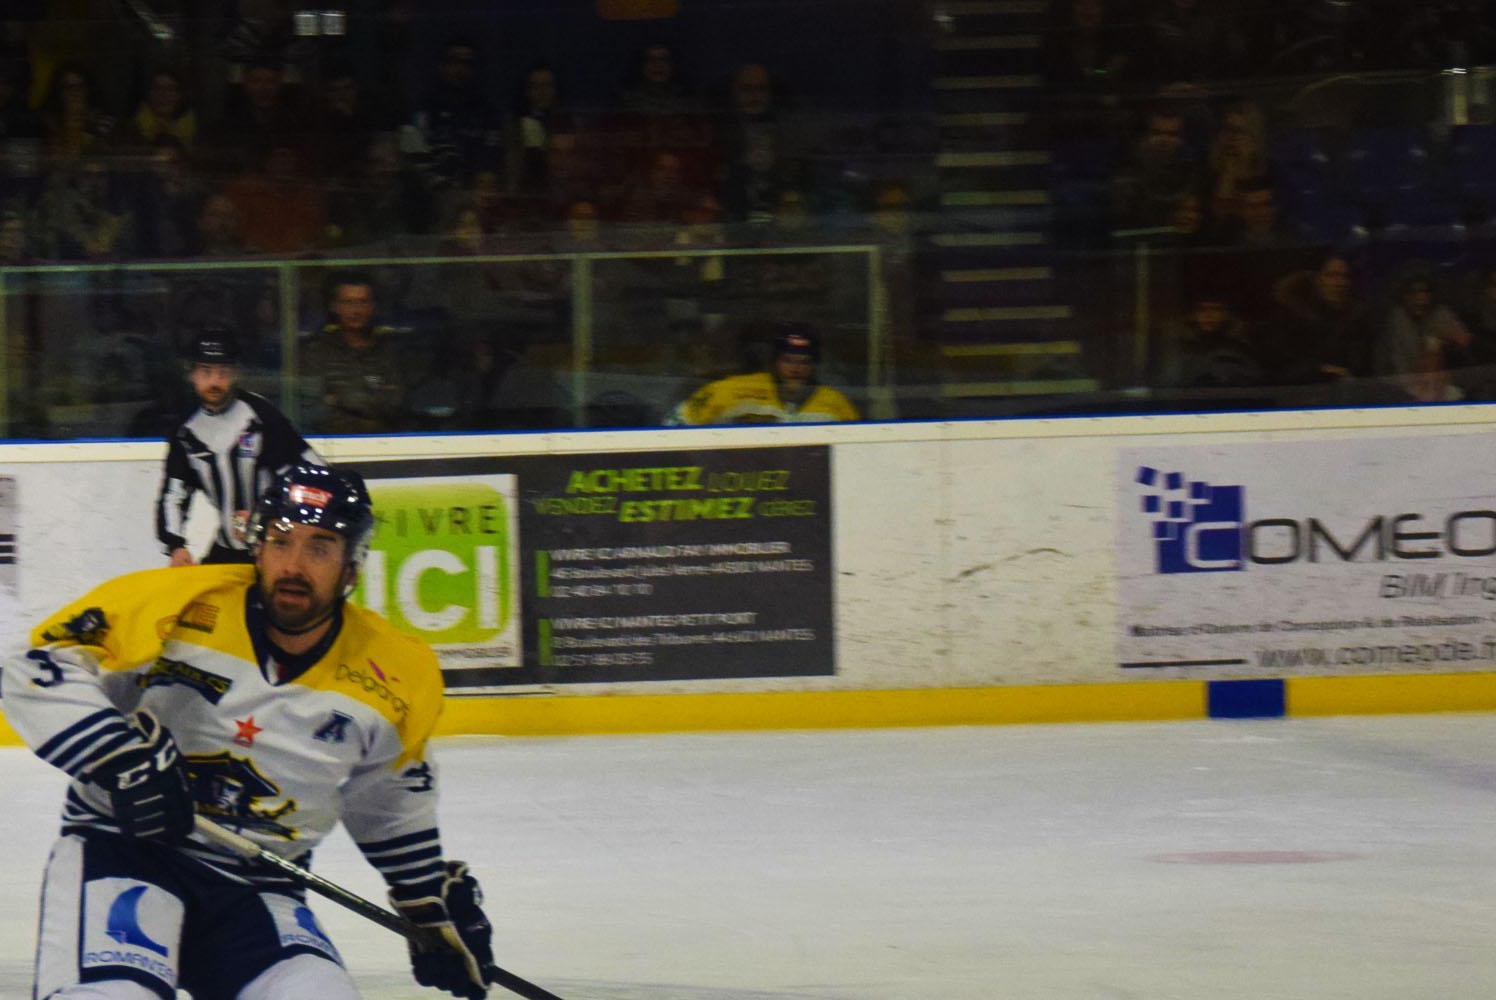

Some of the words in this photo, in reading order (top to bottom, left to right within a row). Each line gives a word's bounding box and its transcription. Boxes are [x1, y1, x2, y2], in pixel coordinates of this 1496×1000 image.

[566, 466, 704, 494] ACHETEZ
[618, 496, 757, 523] ESTIMEZ
[363, 544, 501, 632] ICI
[26, 650, 63, 687] 3
[313, 709, 353, 743] A
